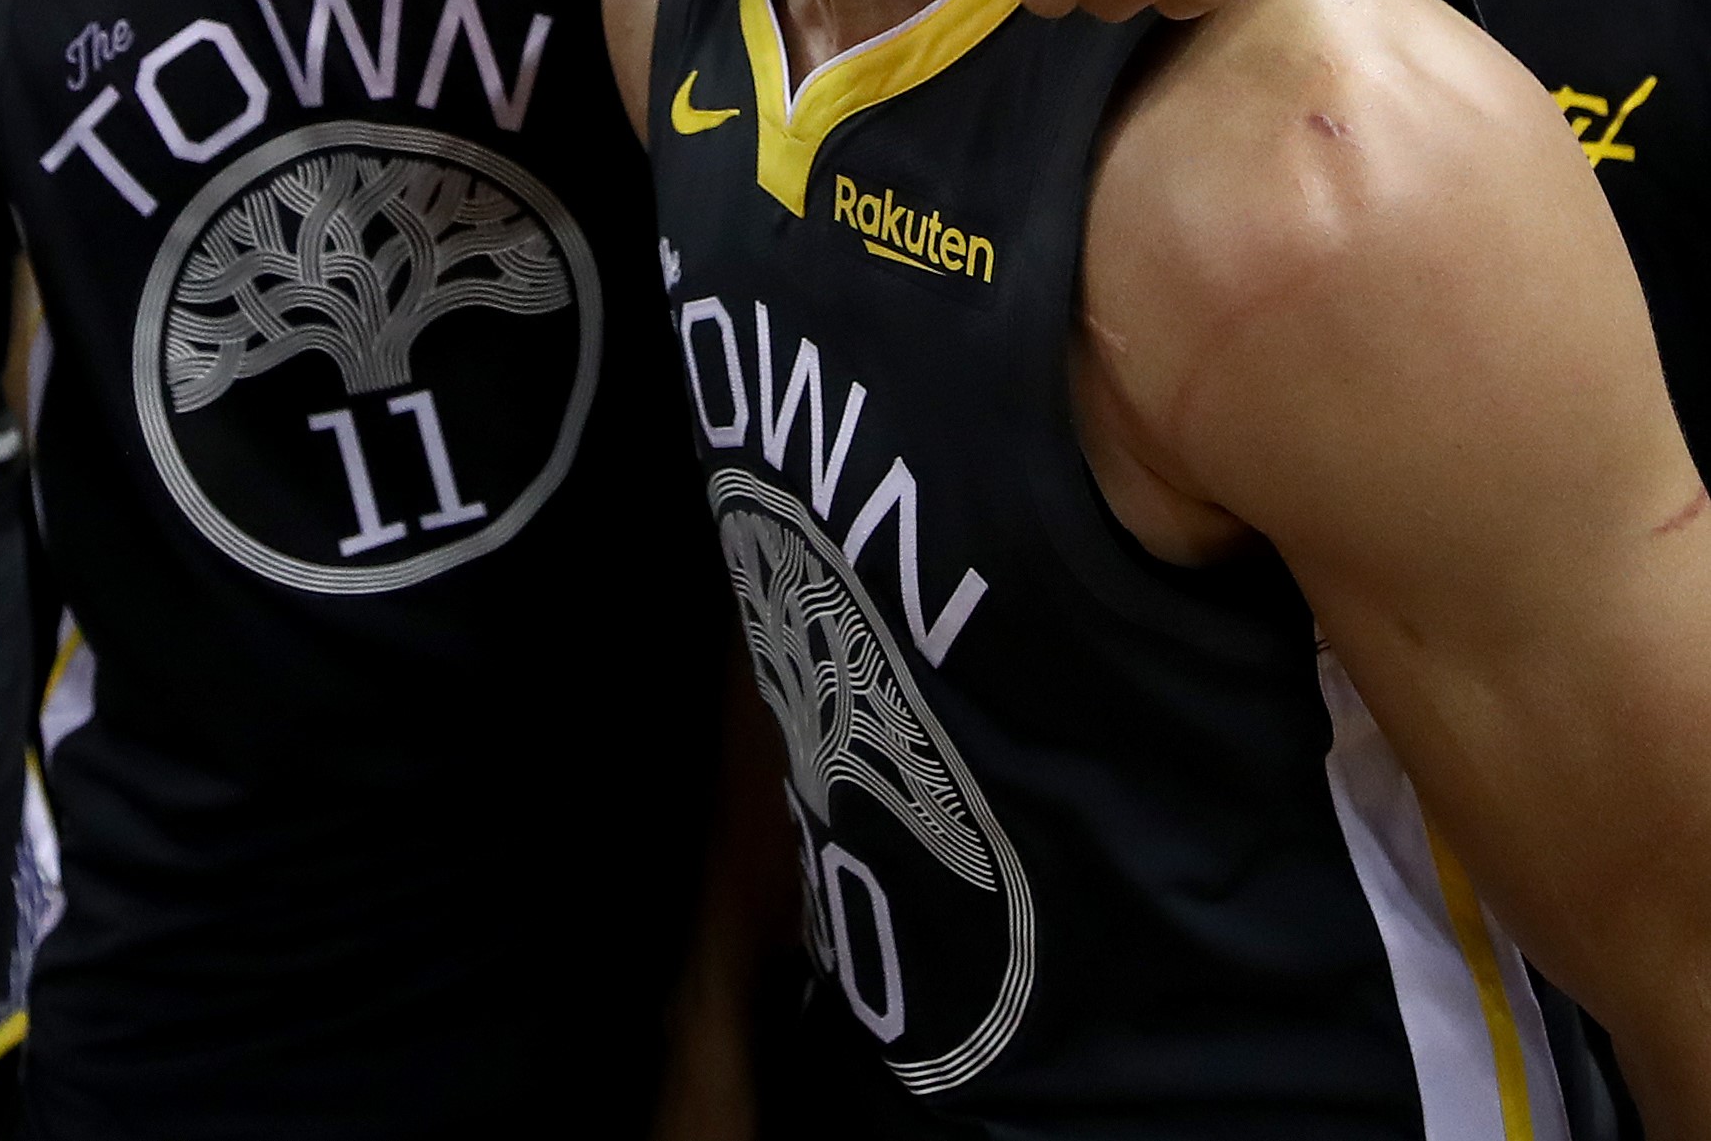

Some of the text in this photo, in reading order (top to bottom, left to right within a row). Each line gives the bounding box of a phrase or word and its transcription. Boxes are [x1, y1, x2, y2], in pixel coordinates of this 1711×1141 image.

[64, 17, 136, 92] The
[833, 173, 997, 285] Rakuten
[306, 389, 489, 559] 11
[672, 294, 989, 671] OWN
